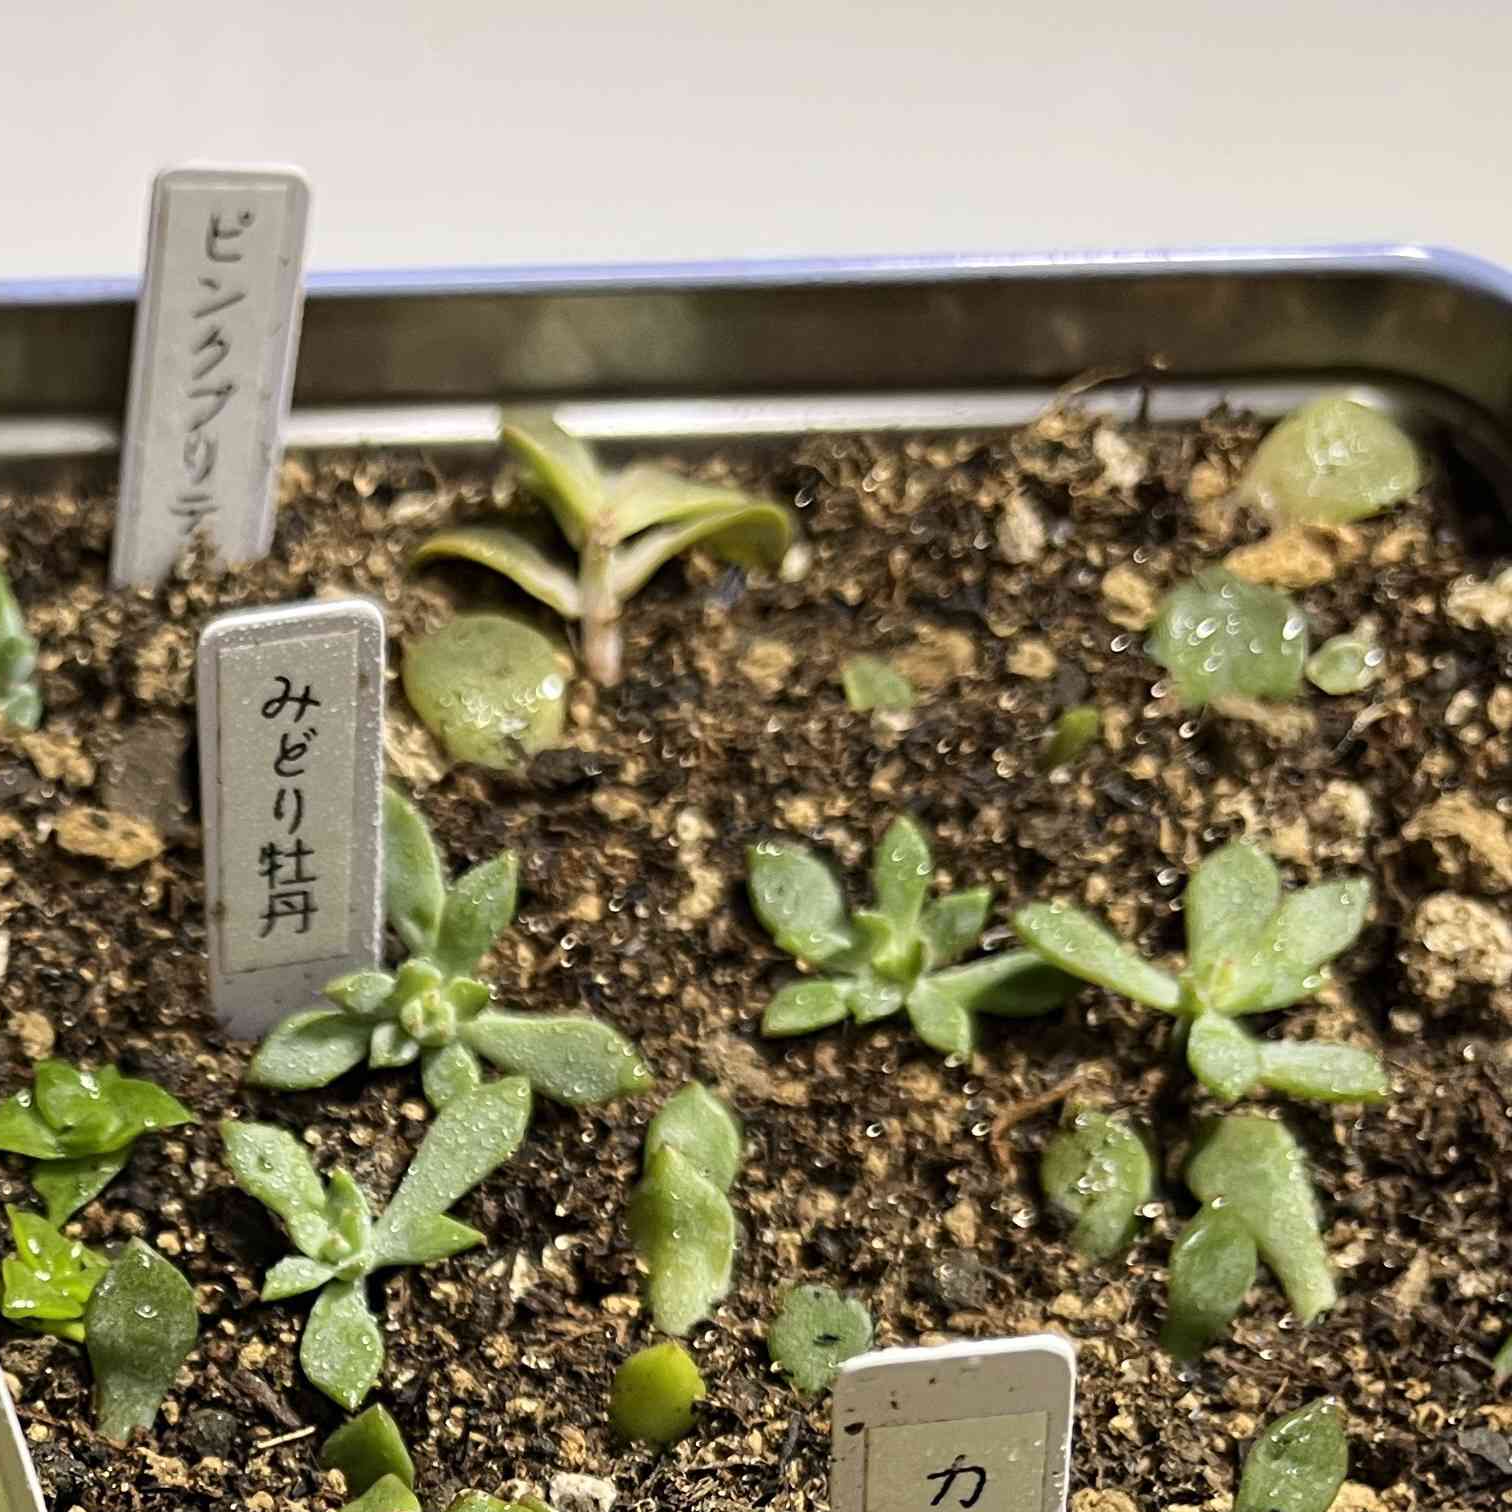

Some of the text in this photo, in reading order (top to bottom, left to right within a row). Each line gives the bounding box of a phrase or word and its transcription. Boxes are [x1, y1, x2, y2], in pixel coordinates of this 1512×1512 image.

[258, 675, 321, 938] みどり牡丹
